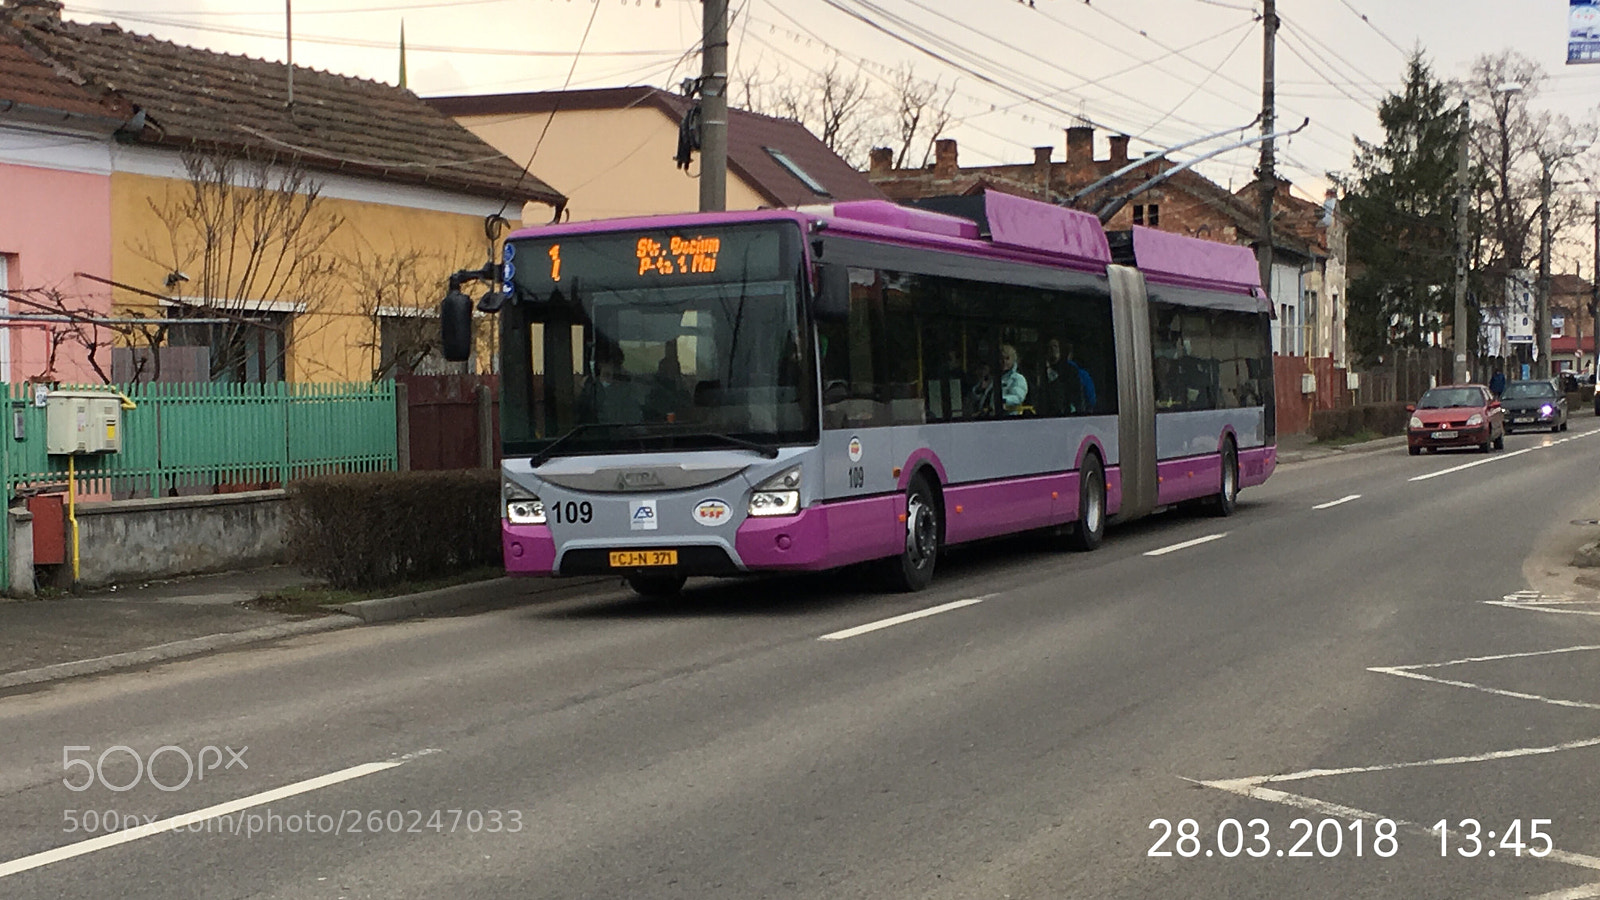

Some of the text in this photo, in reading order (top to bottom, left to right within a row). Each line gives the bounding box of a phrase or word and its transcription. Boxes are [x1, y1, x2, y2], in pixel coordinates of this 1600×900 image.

[636, 237, 667, 258] Str.
[548, 244, 561, 282] 1
[691, 253, 717, 273] Mai
[849, 466, 864, 488] 109
[552, 501, 593, 523] 109
[618, 552, 672, 565] CJ-N 371
